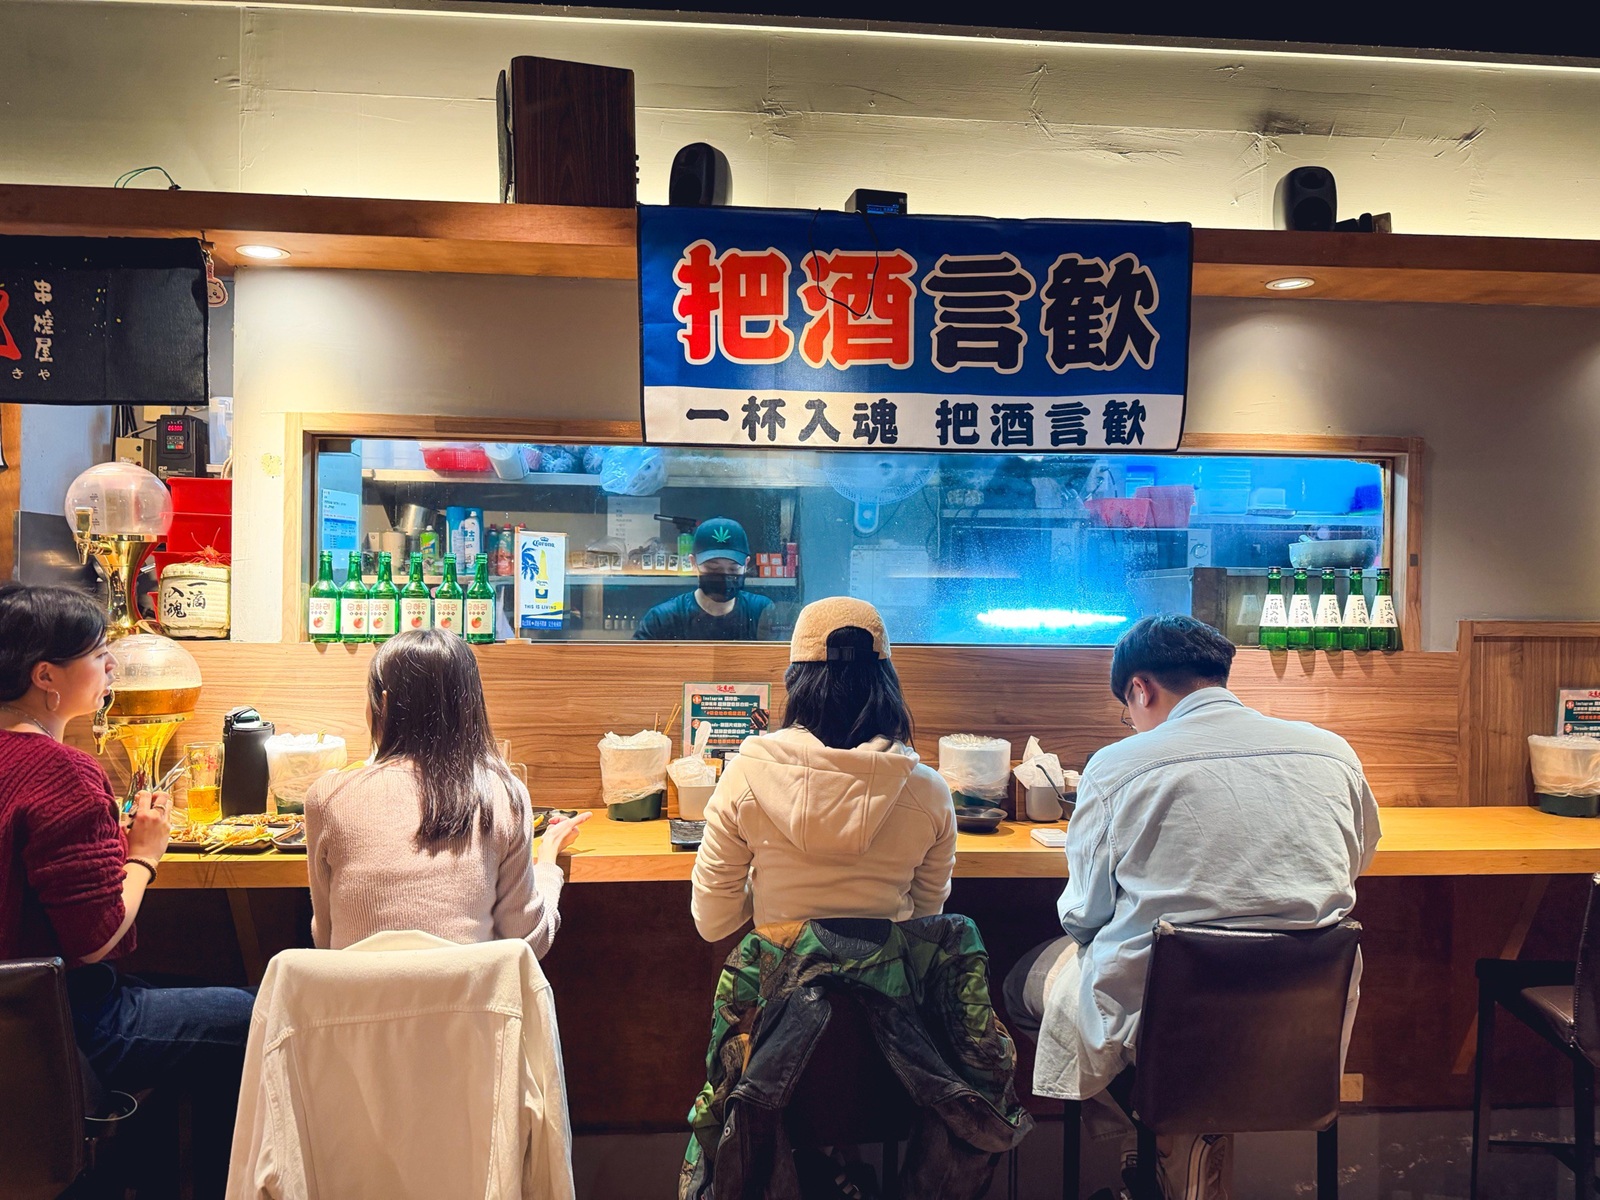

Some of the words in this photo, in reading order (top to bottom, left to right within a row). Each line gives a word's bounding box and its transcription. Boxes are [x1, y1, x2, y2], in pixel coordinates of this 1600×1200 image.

[672, 239, 1160, 374] 把酒言歡
[686, 395, 899, 445] 一杯入魂
[935, 398, 1147, 446] 把酒言歡
[532, 539, 555, 548] Corona
[166, 586, 187, 619] 入魂
